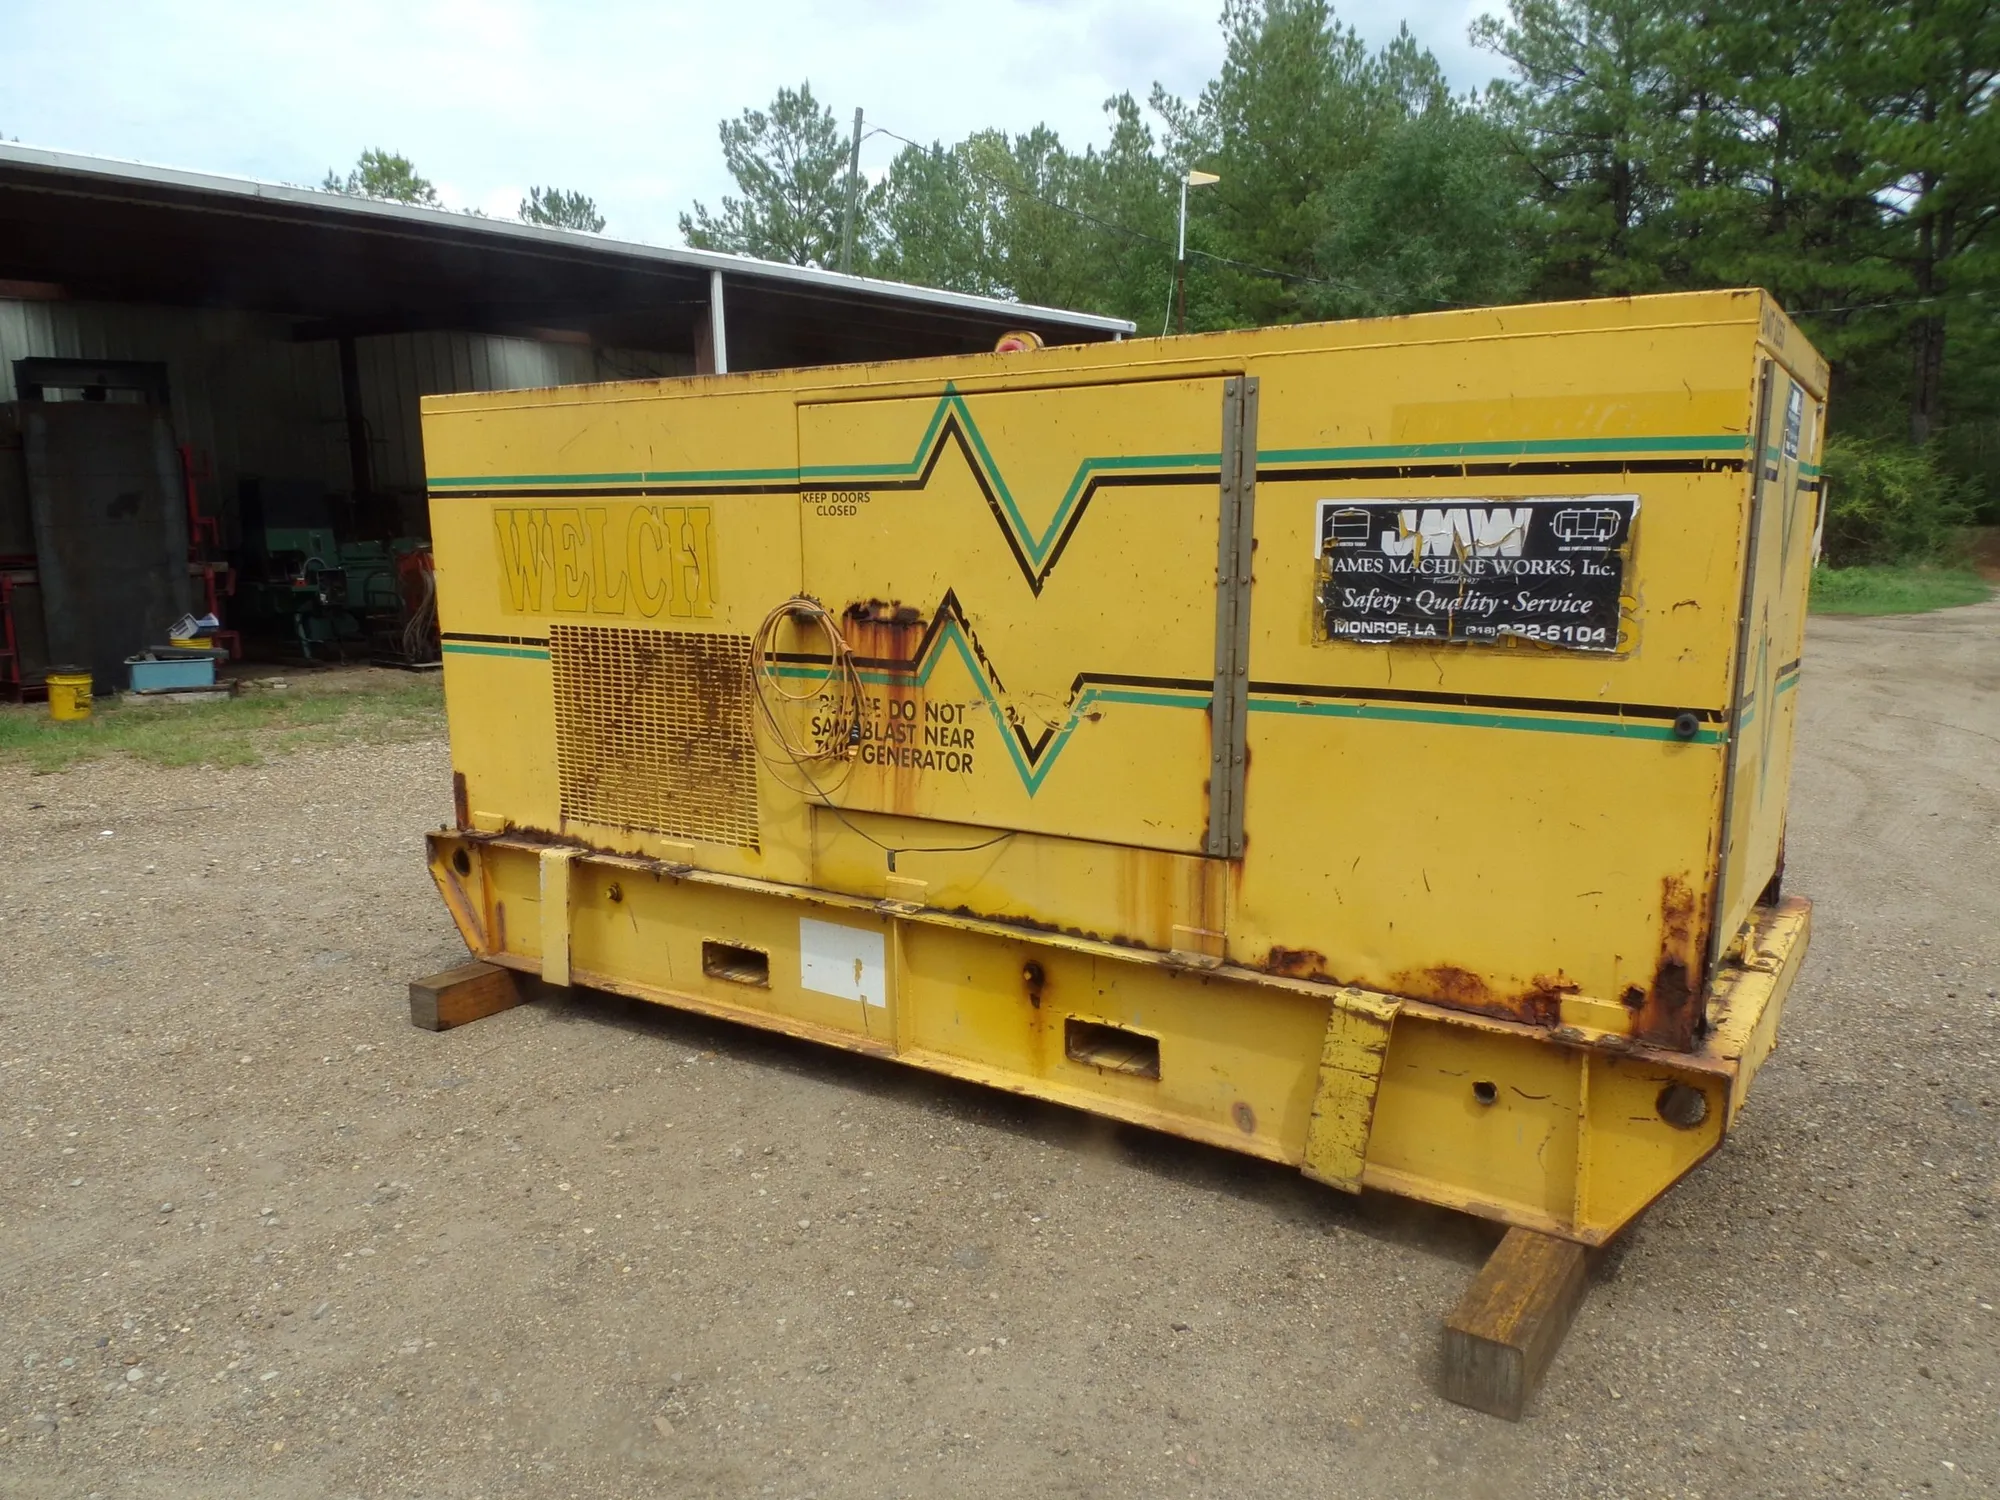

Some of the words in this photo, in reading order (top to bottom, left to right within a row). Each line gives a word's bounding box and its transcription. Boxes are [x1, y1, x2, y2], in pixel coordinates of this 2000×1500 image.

[802, 492, 827, 504] KEEP
[831, 492, 871, 503] DOORS
[816, 505, 857, 516] CLOSED
[1381, 508, 1533, 556] JMW
[494, 505, 716, 618] WELCH
[1331, 557, 1384, 573] AMES
[1389, 557, 1486, 575] MACHINE
[1493, 559, 1576, 577] WORKS,
[1581, 559, 1616, 576] Inc.
[1342, 587, 1402, 615] Safety
[1415, 589, 1499, 618] Quality
[1512, 590, 1593, 614] Service
[1334, 619, 1411, 637] MONROE,
[1414, 622, 1437, 636] LA
[889, 699, 916, 721] DO
[925, 701, 965, 725] NOT
[924, 725, 974, 749] NEAR
[862, 743, 973, 774] GENERATOR
